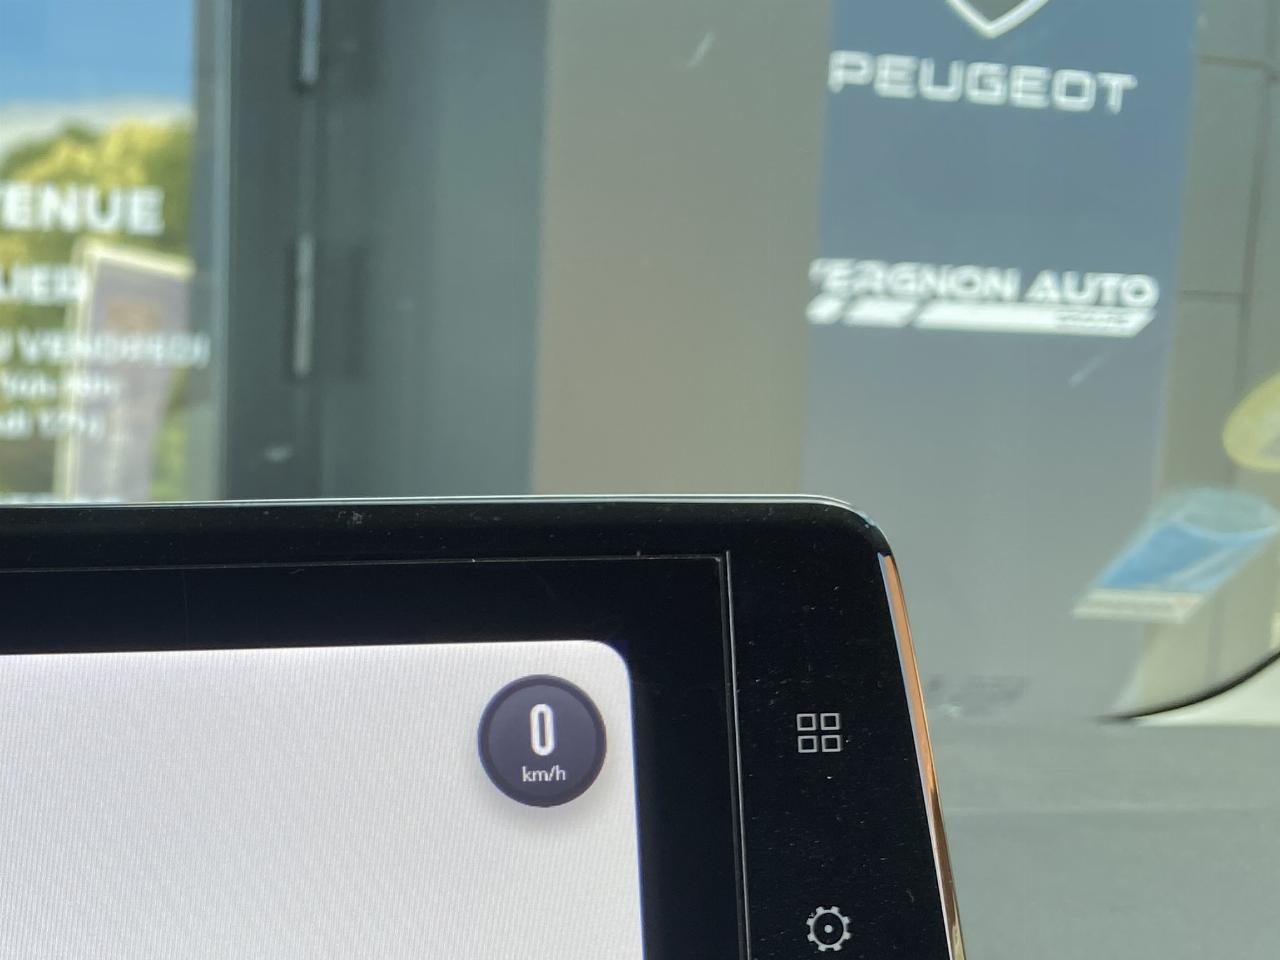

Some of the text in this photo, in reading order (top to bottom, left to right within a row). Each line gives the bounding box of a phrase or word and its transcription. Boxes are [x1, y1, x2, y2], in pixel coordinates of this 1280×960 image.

[828, 50, 1138, 114] PEUGEOT
[1025, 270, 1160, 308] AUTO
[529, 703, 555, 757] 0
[521, 764, 567, 783] km/h
